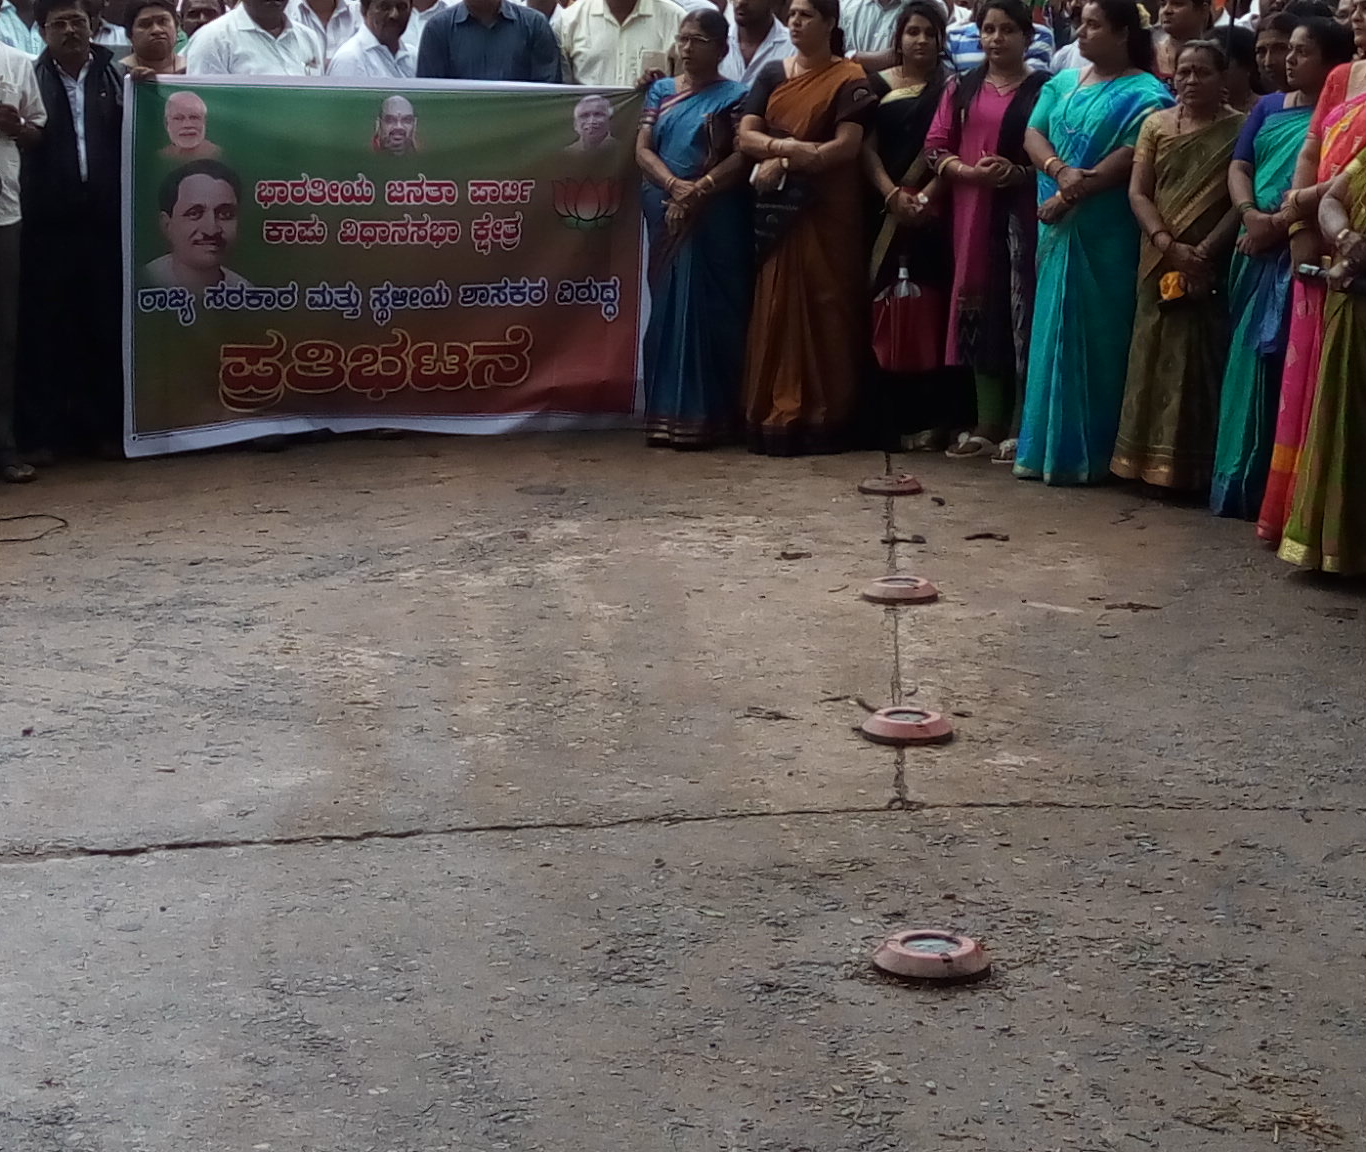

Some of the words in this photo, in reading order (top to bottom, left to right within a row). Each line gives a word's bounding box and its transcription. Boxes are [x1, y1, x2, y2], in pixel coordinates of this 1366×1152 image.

[255, 173, 374, 206] ಭಾರತೀಯ
[385, 178, 459, 206] ಜನತಾ
[469, 174, 536, 206] ಪಾರ್ಟಿ
[262, 218, 327, 246] ಕಾಪು
[337, 214, 461, 248] ವಿಧಾನಸಭಾ
[471, 213, 524, 254] ಕ್ಷೇತ್ರ
[138, 284, 196, 325] ರಾಜ್ಯ
[204, 282, 298, 311] ಸರಕಾರ
[305, 282, 362, 319] ಮತ್ತು
[369, 280, 450, 325] ಸ್ಥಳೀಯ
[458, 276, 547, 307] ಶಾಸಕರ
[554, 275, 620, 322] ವಿರುದ್ಧ
[218, 324, 533, 412] ಪ್ರತಿಭಟನೆ
